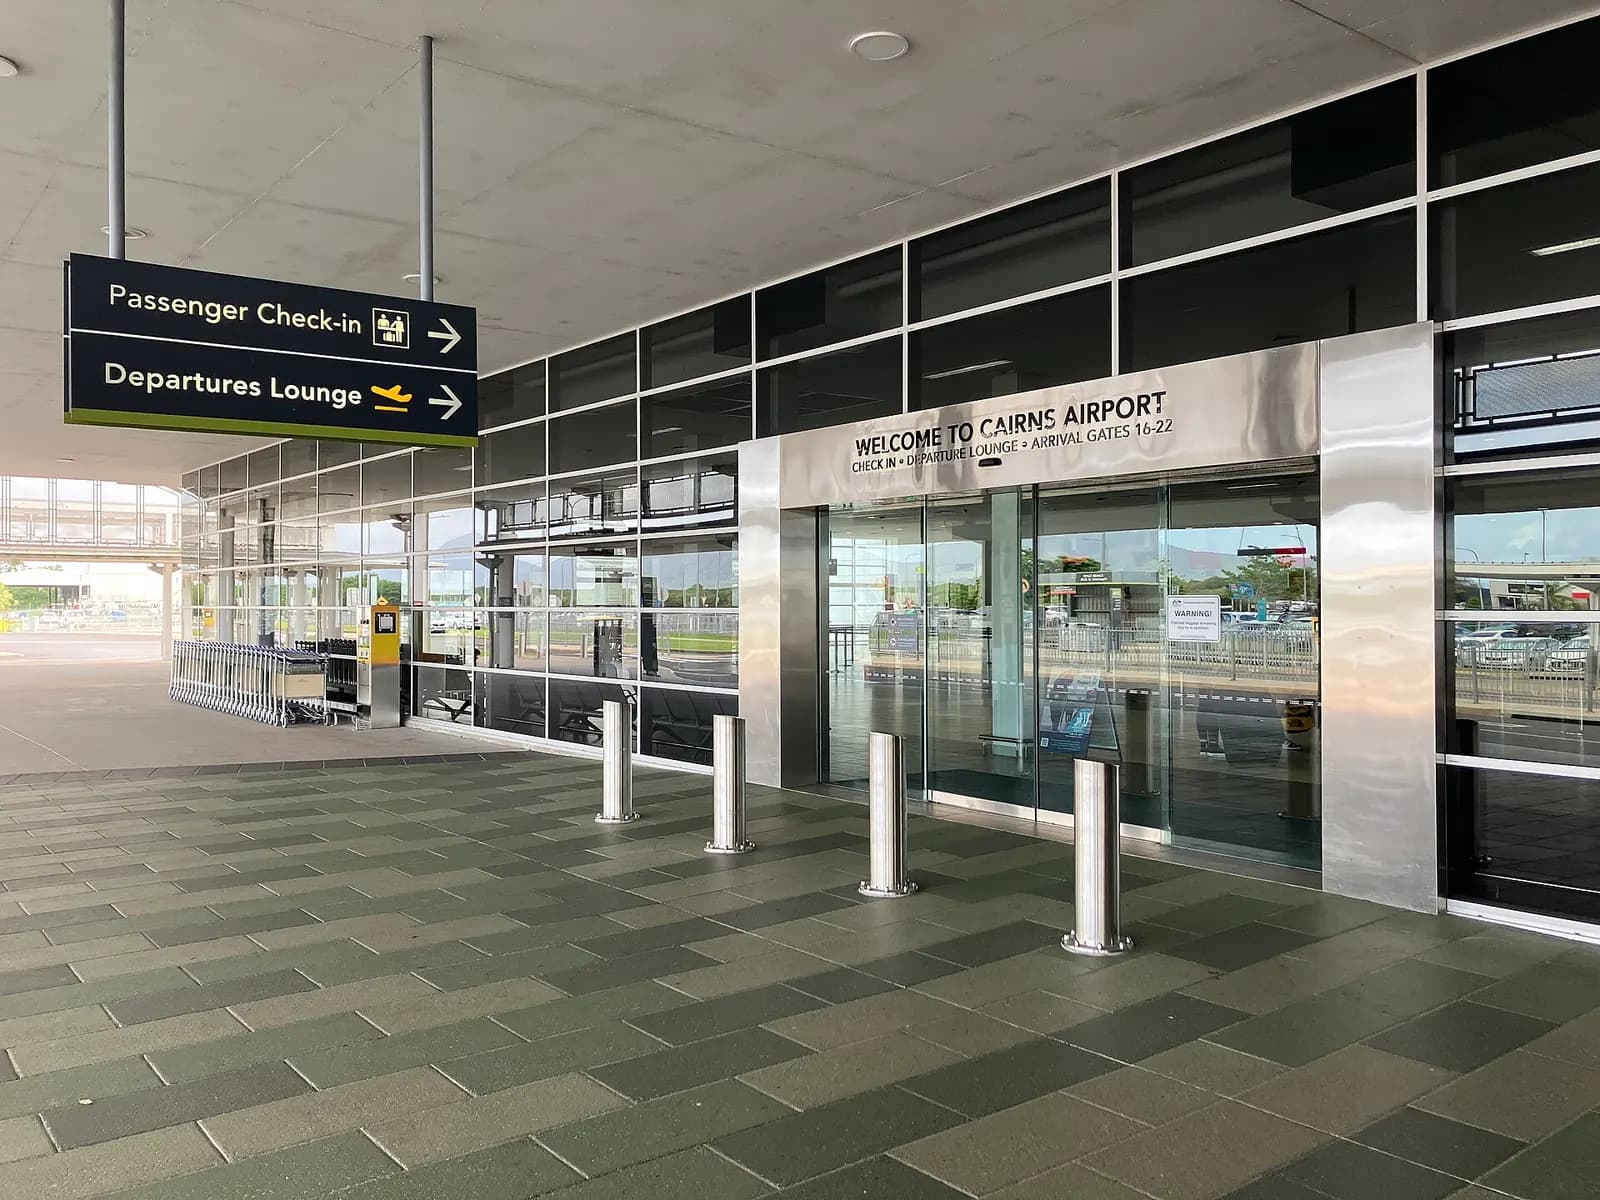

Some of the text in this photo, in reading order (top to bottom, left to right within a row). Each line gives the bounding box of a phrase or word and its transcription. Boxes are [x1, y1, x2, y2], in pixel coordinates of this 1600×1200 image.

[109, 283, 362, 335] Passenger Check-in
[105, 362, 362, 409] Departures Lounge
[852, 418, 1173, 473] CHECK IN DEPARTURE LOUNGE ARRIVAL GATES 16-22
[855, 391, 1167, 456] WELCOME TO CAIRNS AIRPORT
[1174, 609, 1213, 617] WARNING!
